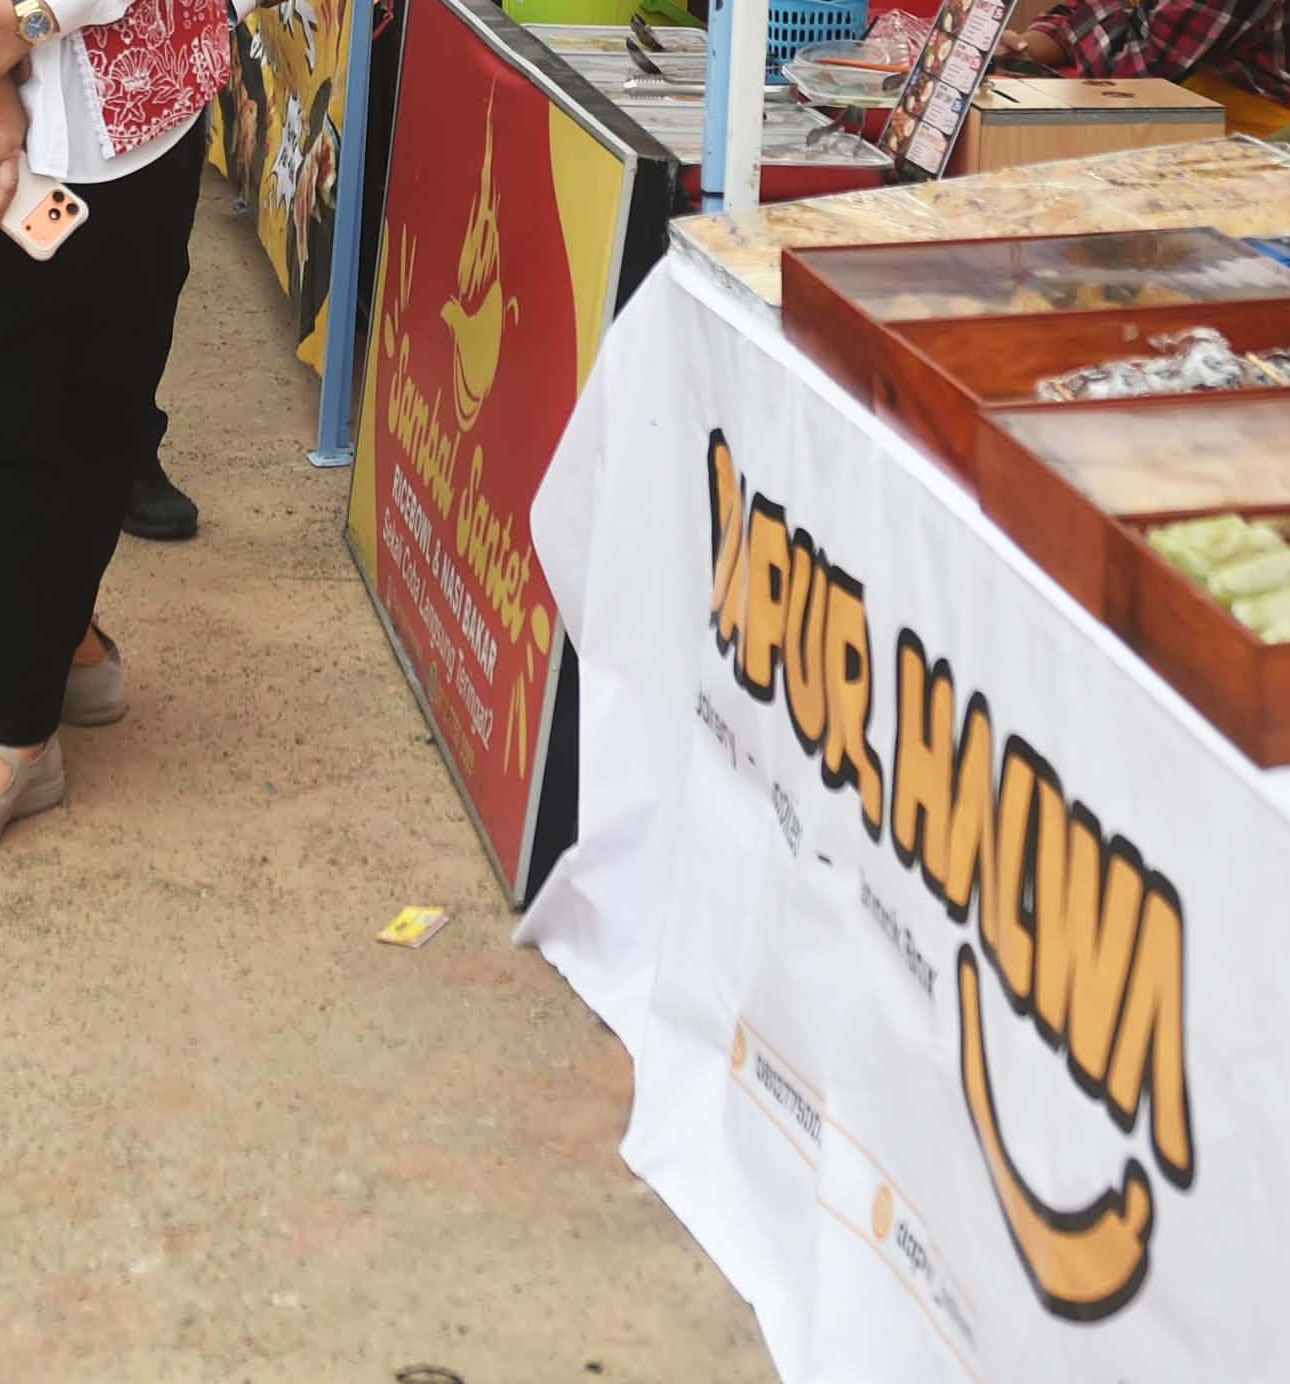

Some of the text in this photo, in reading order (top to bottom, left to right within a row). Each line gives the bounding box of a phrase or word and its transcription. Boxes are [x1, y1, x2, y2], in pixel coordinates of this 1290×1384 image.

[388, 332, 462, 520] Sambal
[457, 444, 532, 645] Santet
[392, 464, 432, 565] RICEBOWL
[440, 551, 465, 625] NASI
[462, 591, 498, 687] BAKAR
[891, 627, 1195, 1191] HALWA
